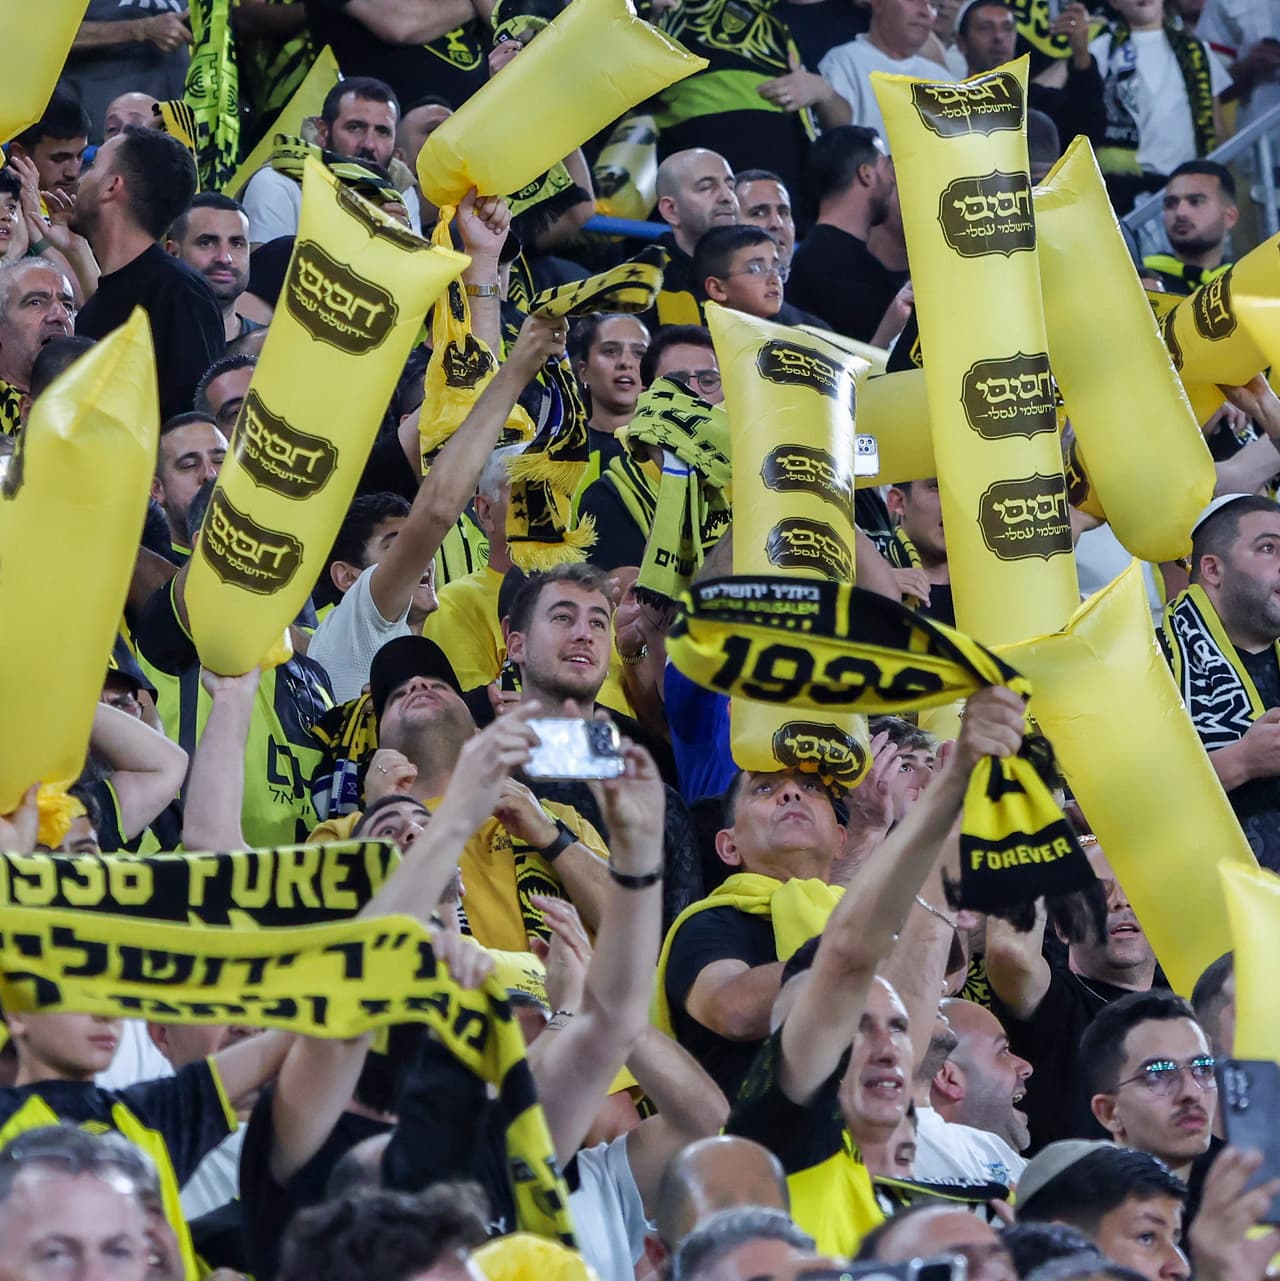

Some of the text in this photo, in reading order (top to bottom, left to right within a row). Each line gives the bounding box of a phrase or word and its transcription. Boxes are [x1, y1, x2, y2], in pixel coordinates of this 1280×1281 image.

[952, 185, 1031, 221] חביבי
[965, 222, 995, 238] עסלי
[975, 369, 1051, 404] חביבי
[987, 403, 1018, 420] עסלי
[992, 489, 1068, 525] חביבי
[1004, 525, 1035, 541] עסלי
[970, 837, 1072, 871] FOREVER
[187, 840, 401, 911] FOREV
